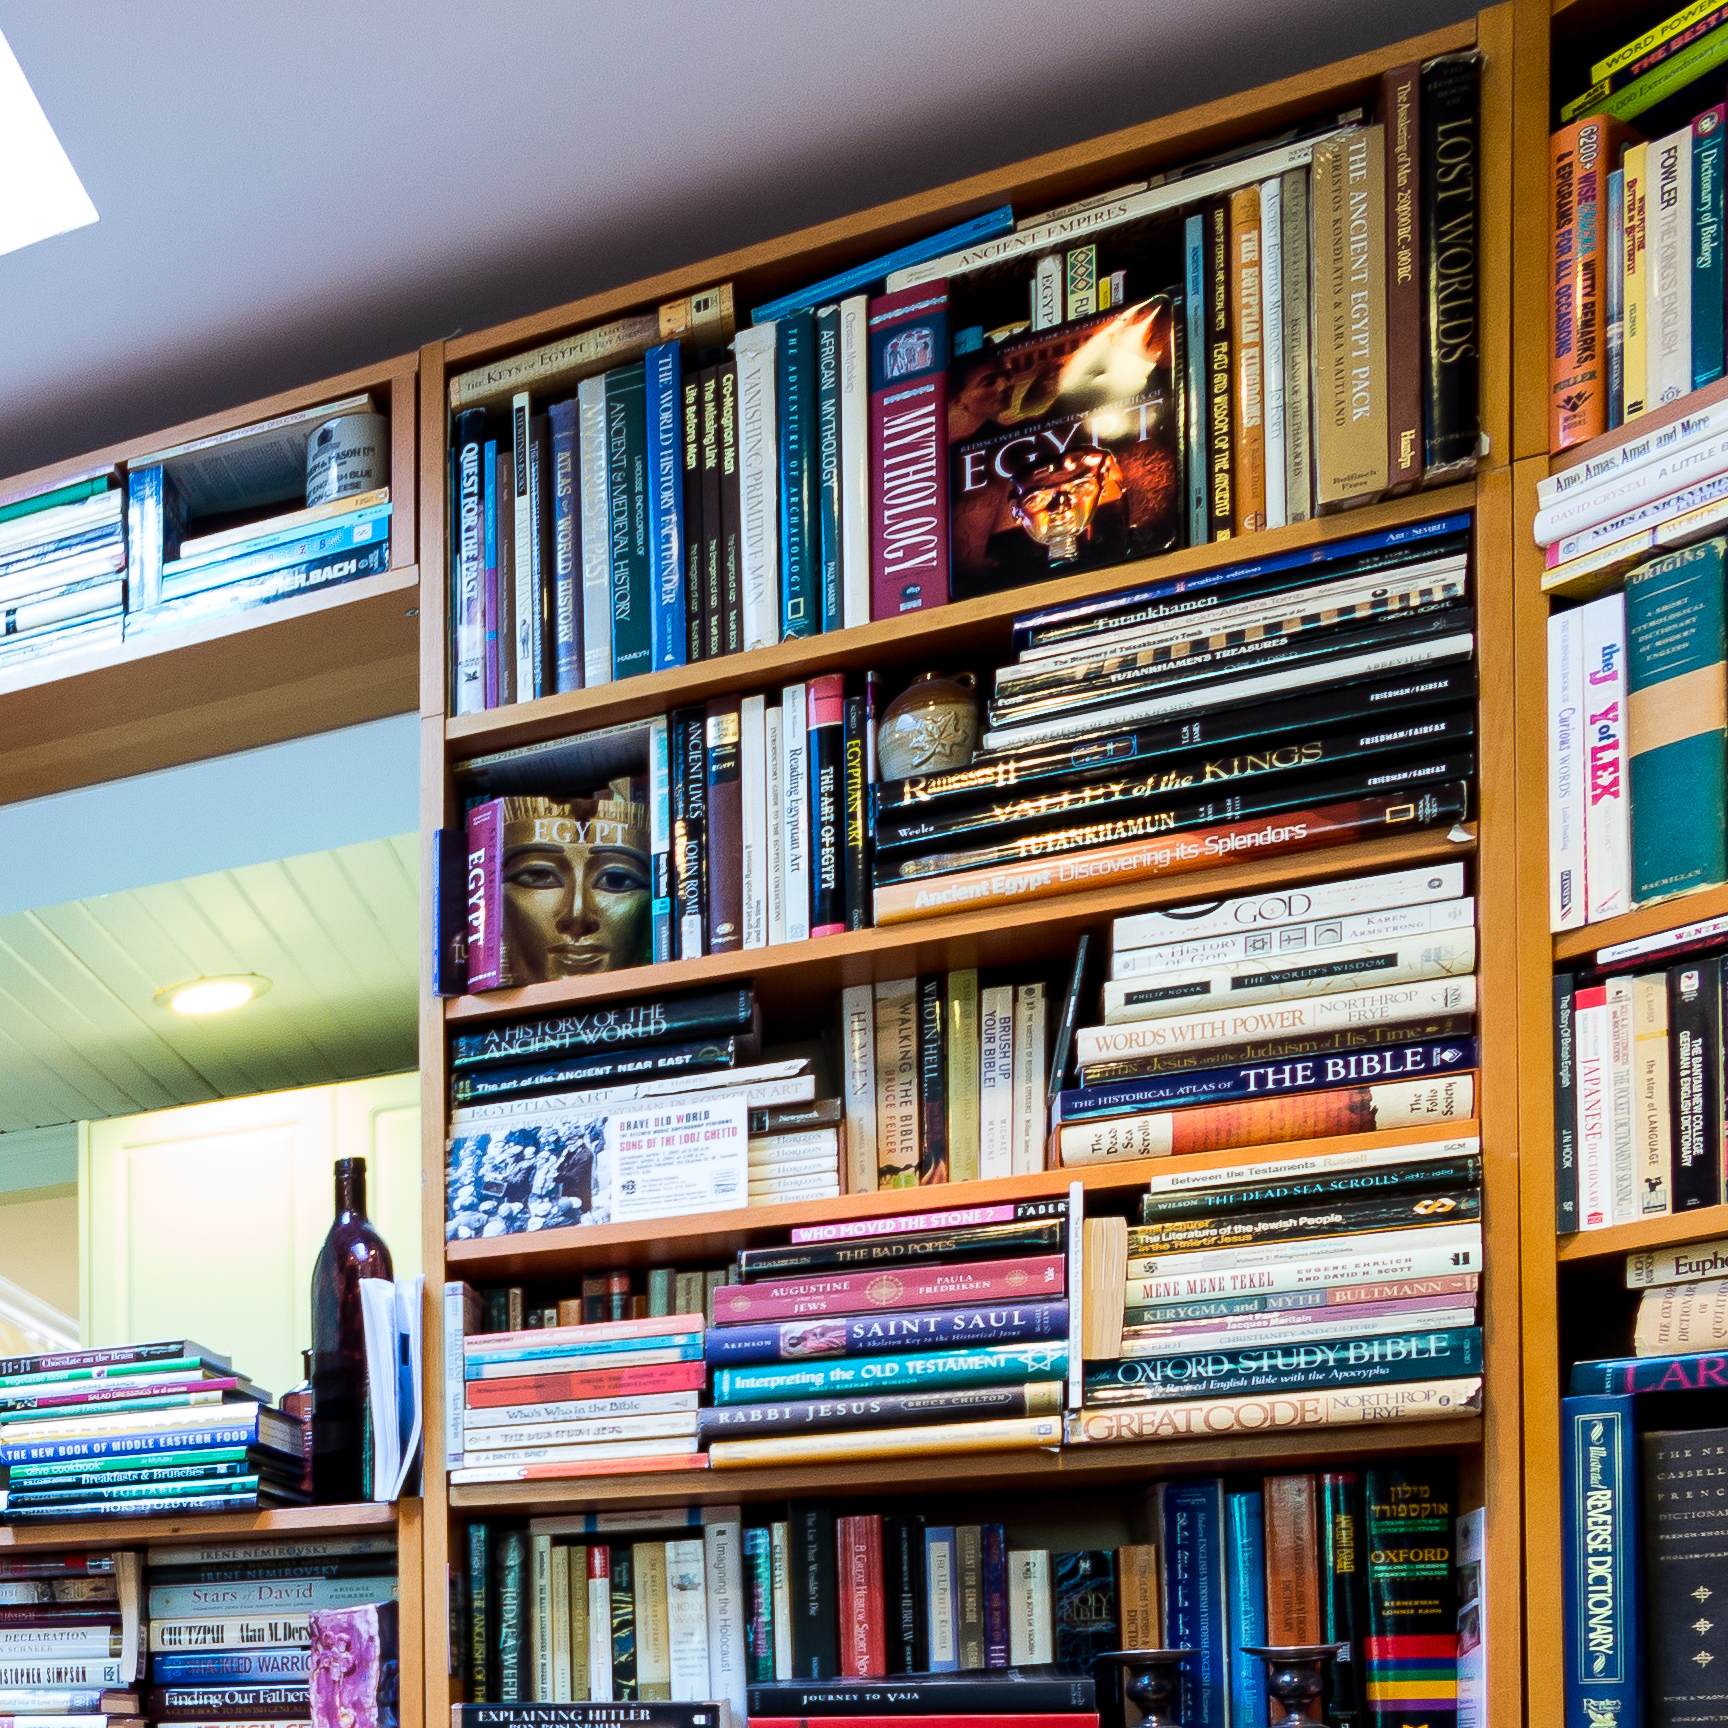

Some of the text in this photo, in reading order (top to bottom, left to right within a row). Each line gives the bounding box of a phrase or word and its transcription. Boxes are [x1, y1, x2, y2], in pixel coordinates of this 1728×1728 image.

[1437, 118, 1475, 363] LOST WORLDS
[883, 402, 937, 576] MYTHOLOGY
[991, 742, 1324, 822] VALLEY of the KINGS
[532, 817, 628, 844] EGYPT
[1059, 822, 1307, 883] Discovering its Splendors
[1233, 891, 1311, 922] GOD
[1095, 1008, 1305, 1054] WORDS WITH POWER
[1242, 1048, 1424, 1092] THE BIBLE
[850, 1307, 1027, 1340] SAINT SAUL
[1116, 1331, 1450, 1383] OXFORD STUDY BIBLE
[1084, 1397, 1324, 1441] GREAT CODE
[1371, 1503, 1449, 1518] אוקספורד
[1390, 1482, 1430, 1502] מילון
[1371, 1548, 1449, 1563] OXFORD
[1586, 1490, 1613, 1655] REVERSE DICTIONARY
[478, 1707, 651, 1725] EXPLAINING HITLER
